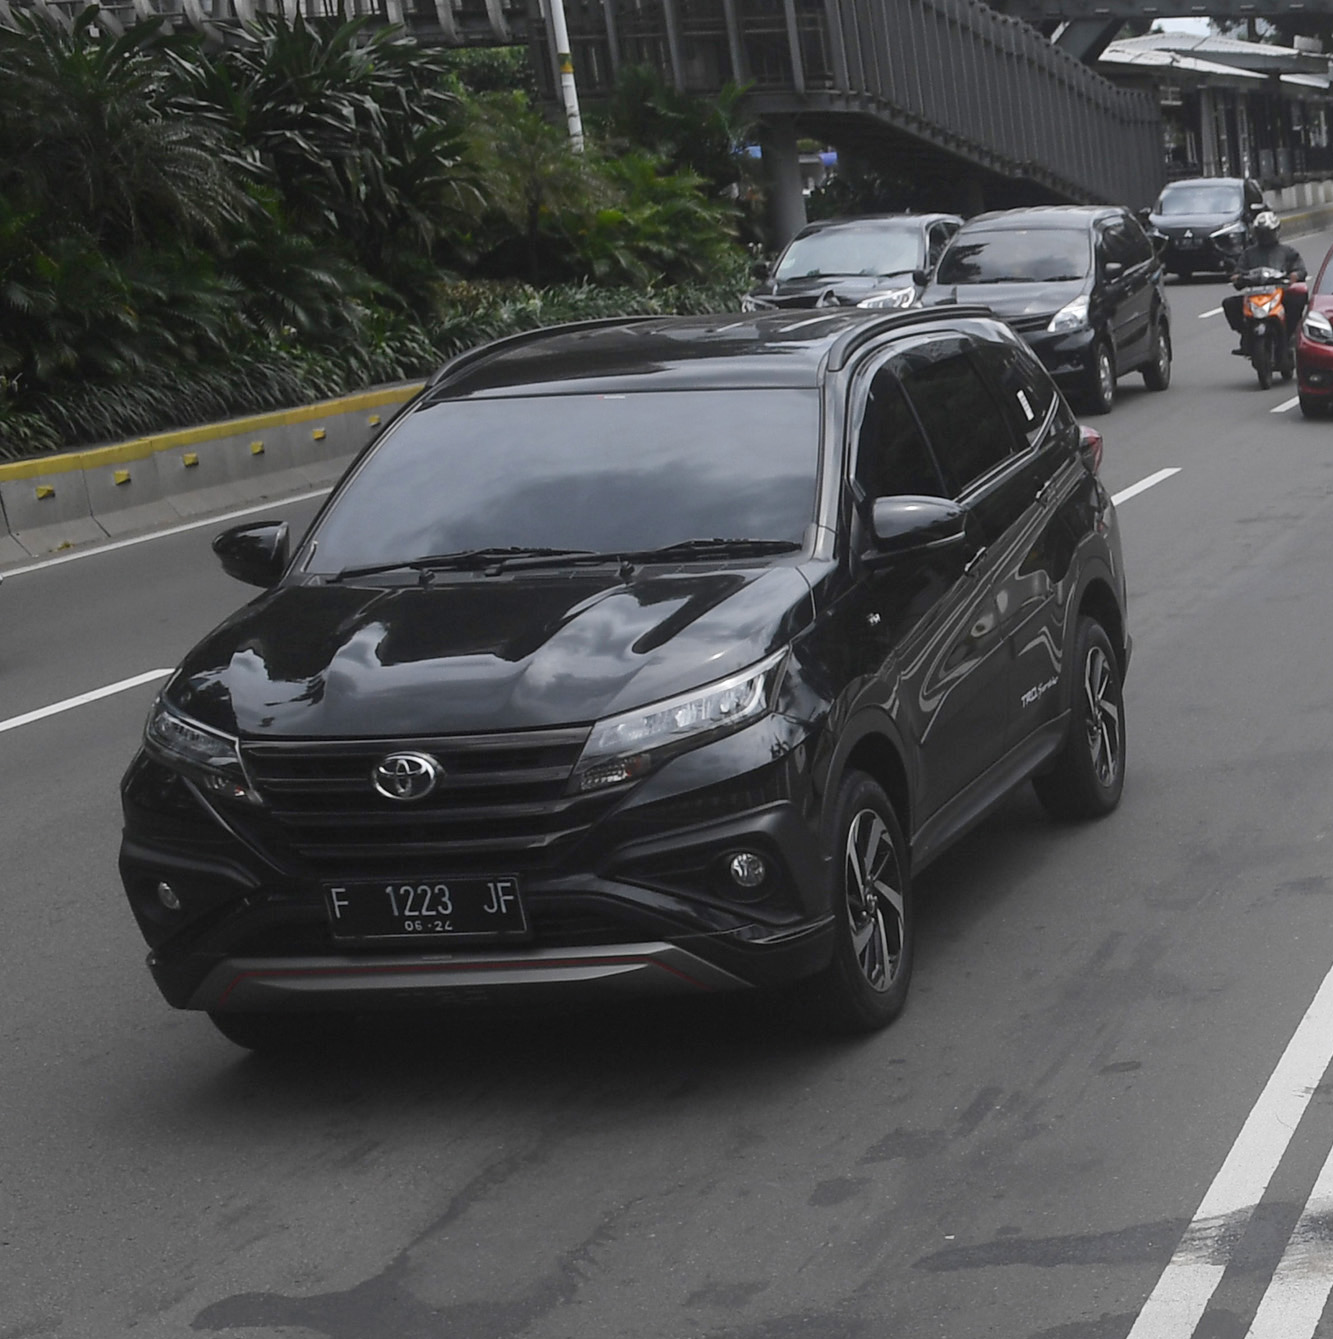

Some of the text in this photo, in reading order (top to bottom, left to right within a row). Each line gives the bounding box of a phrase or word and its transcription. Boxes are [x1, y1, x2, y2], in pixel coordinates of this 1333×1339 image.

[331, 882, 514, 918] F 1223 JF
